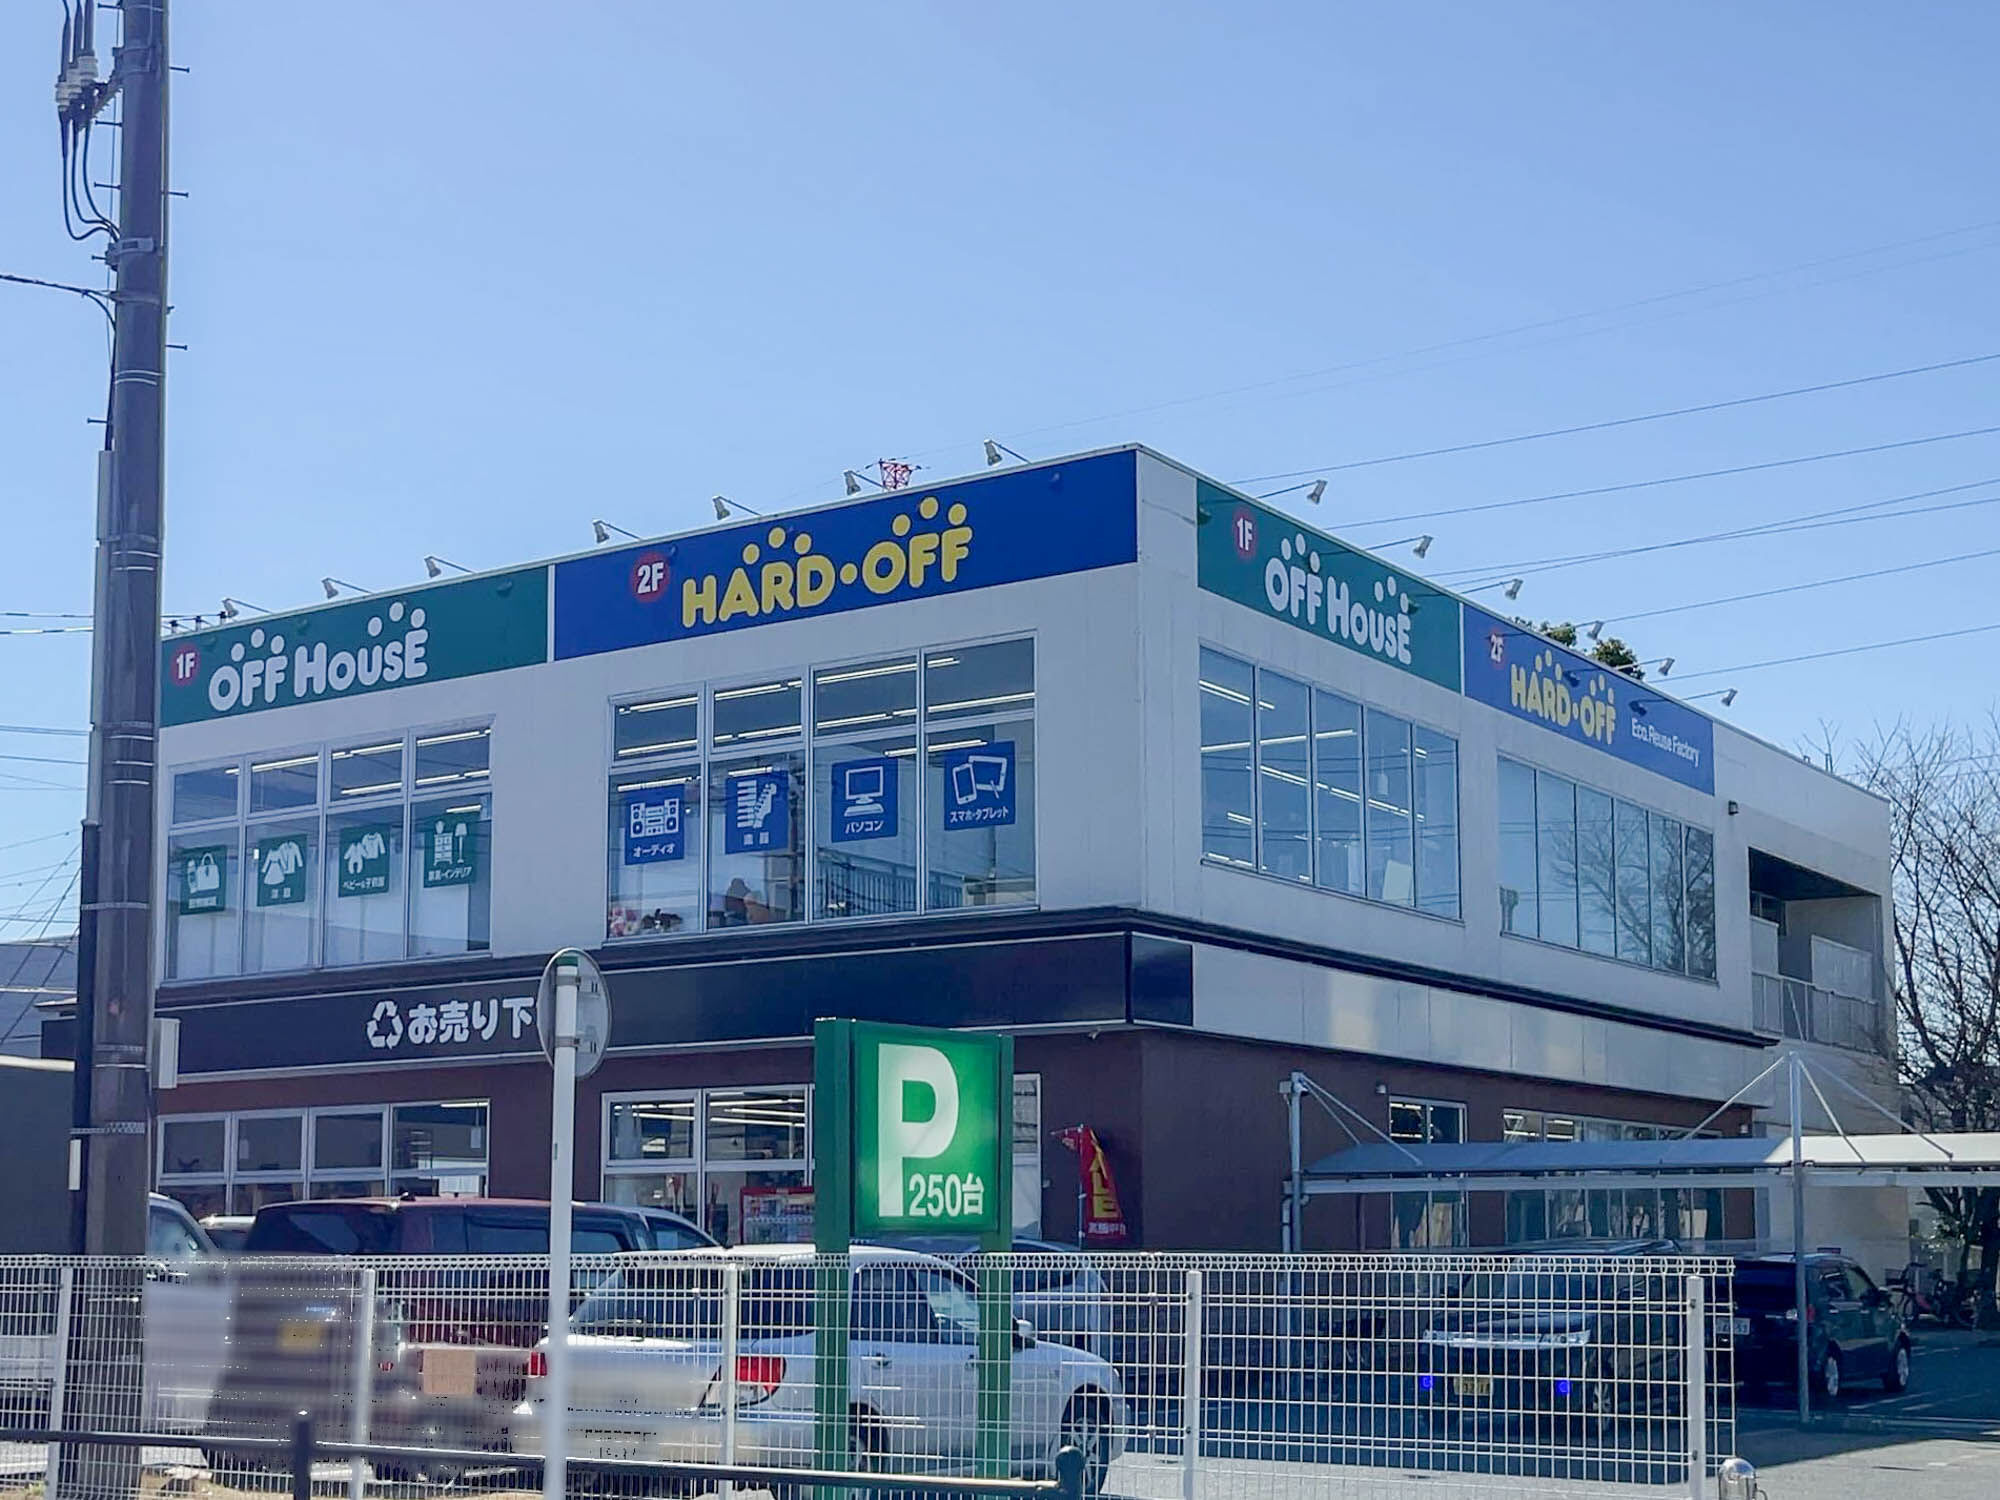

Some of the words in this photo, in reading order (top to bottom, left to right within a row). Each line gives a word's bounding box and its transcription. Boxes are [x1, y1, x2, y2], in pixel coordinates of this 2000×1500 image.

[1236, 517, 1255, 552] 1F
[635, 561, 665, 593] 2F
[1264, 557, 1323, 625] OFF
[1327, 576, 1413, 666] HOUSE
[1490, 633, 1506, 662] 2F
[176, 652, 197, 680] 1F
[208, 657, 287, 712] OFF
[294, 628, 429, 698] HOUSE
[844, 820, 884, 834] パソコン
[632, 843, 676, 857] オーディオ
[878, 1043, 960, 1218] P
[909, 1173, 985, 1217] 250台
